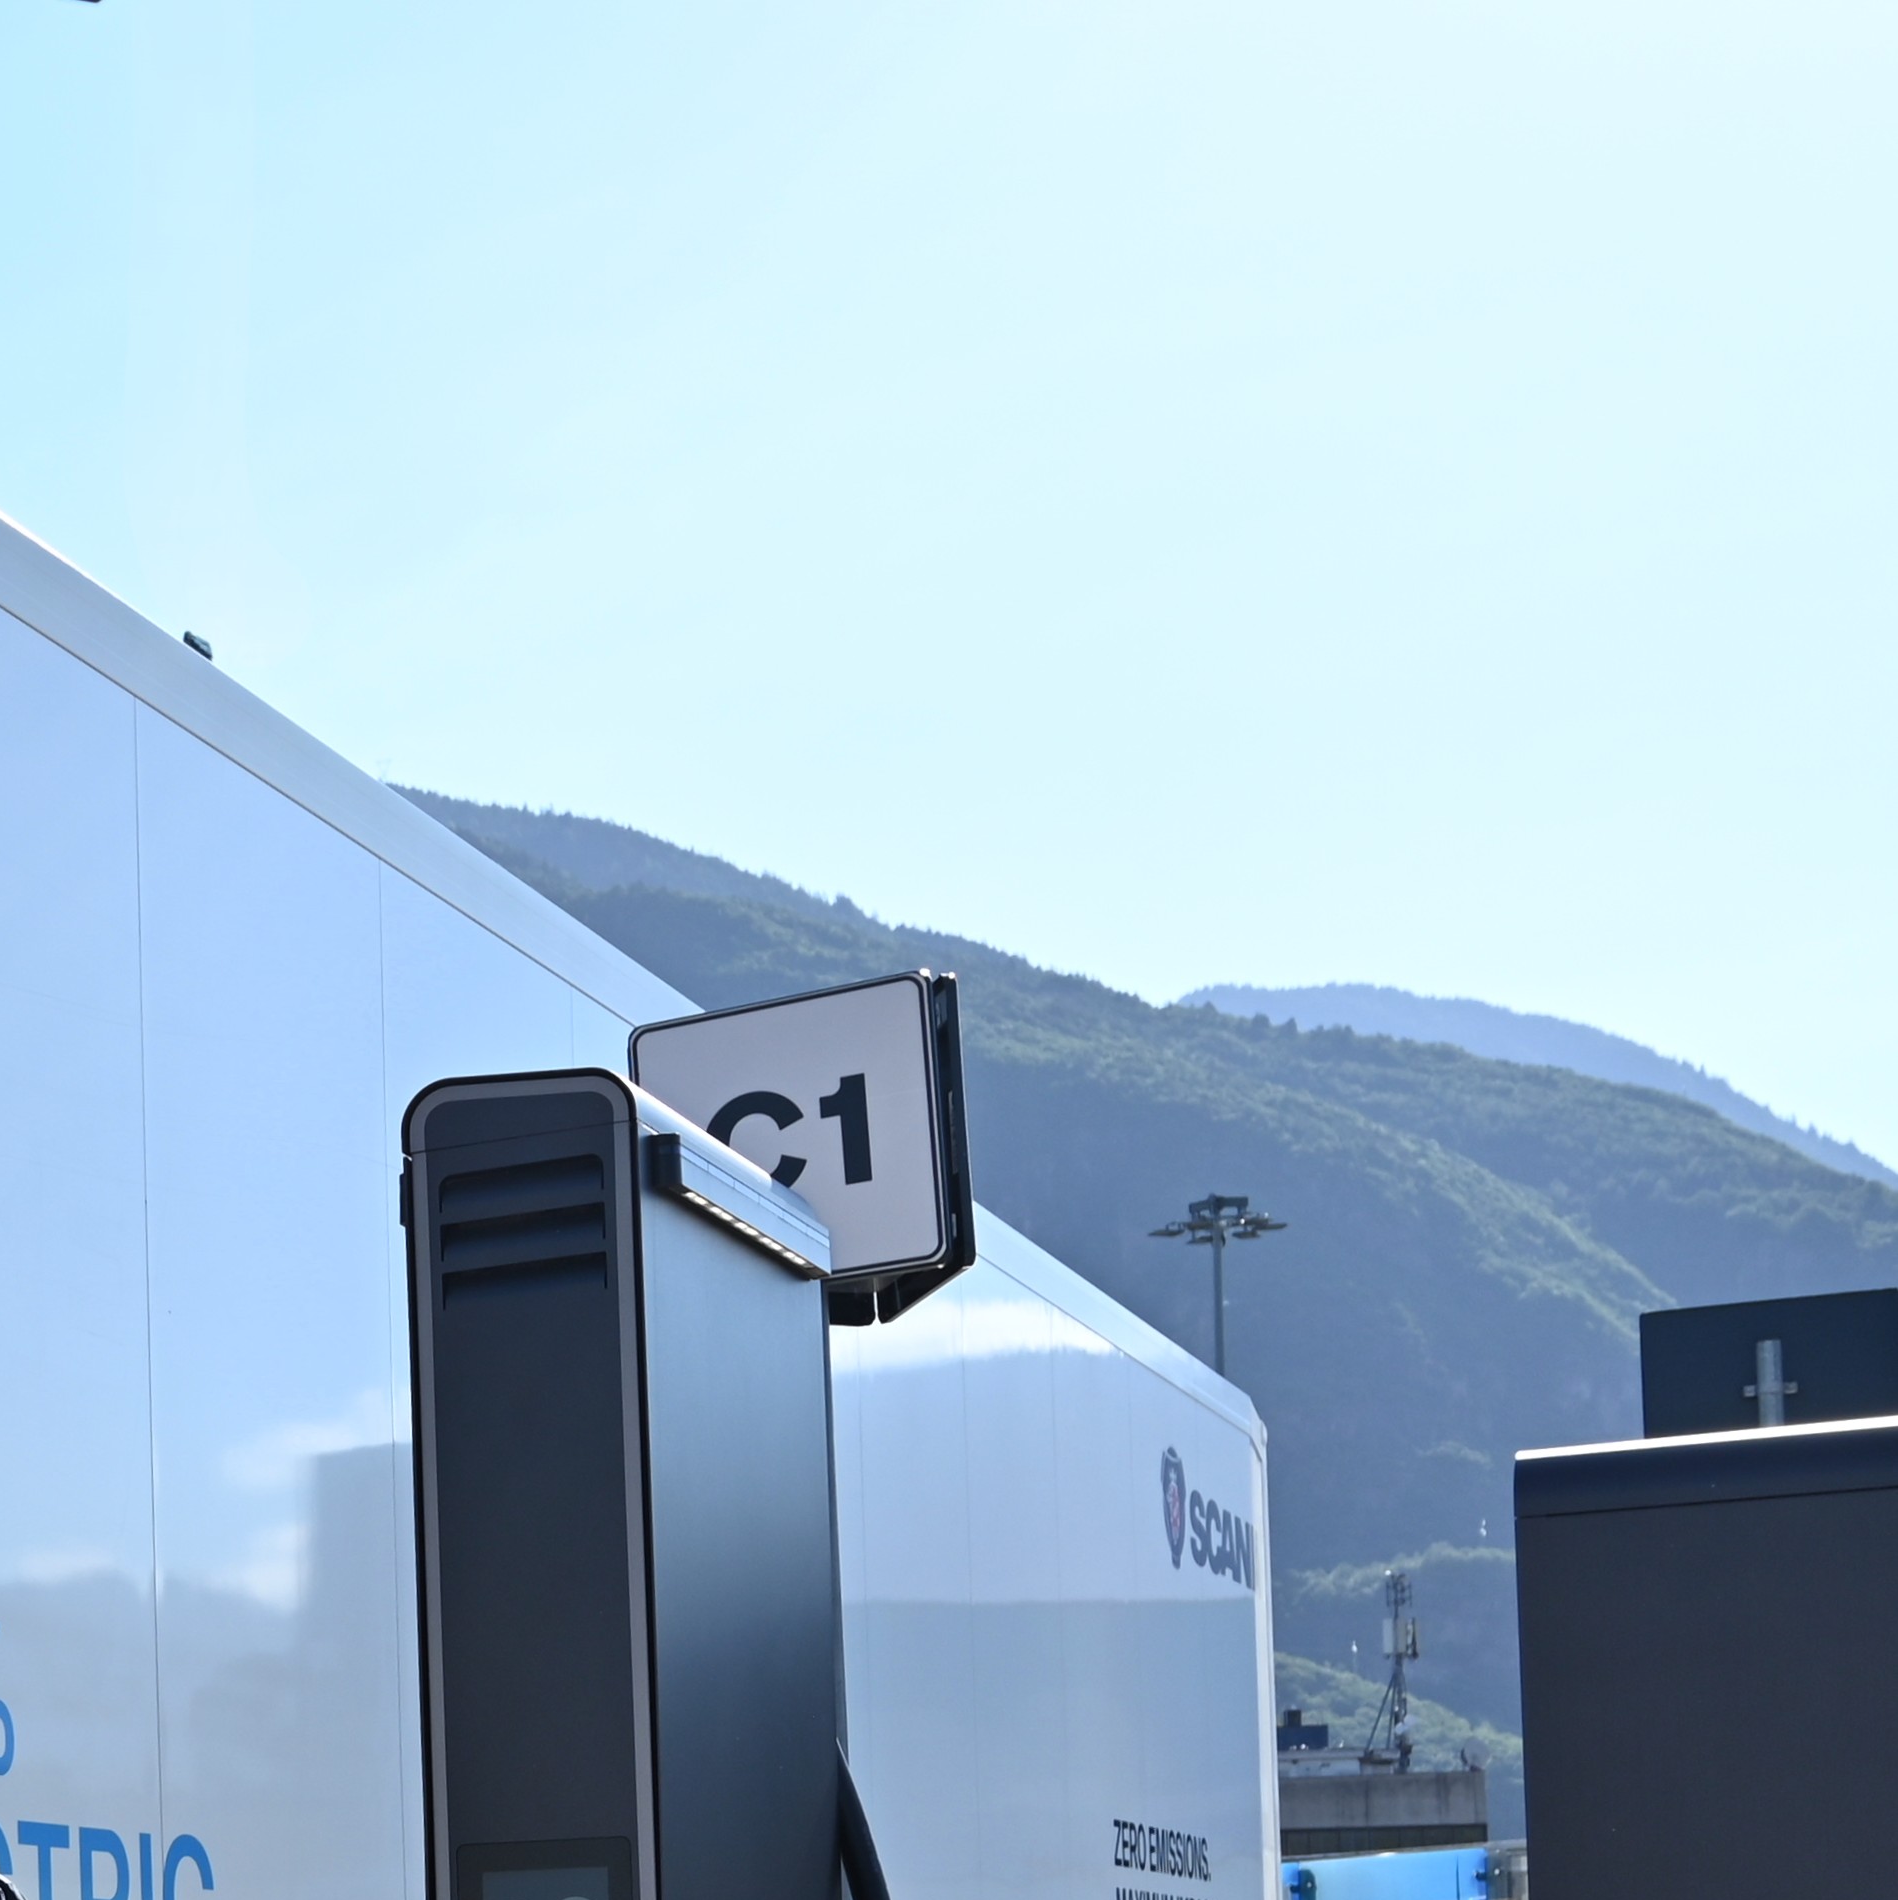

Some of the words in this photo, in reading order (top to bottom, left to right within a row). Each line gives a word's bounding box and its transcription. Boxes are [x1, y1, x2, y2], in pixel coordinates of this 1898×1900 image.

[706, 1072, 874, 1188] C1
[1113, 1819, 1147, 1871] ZERO
[1149, 1826, 1211, 1882] EMISSIONS.
